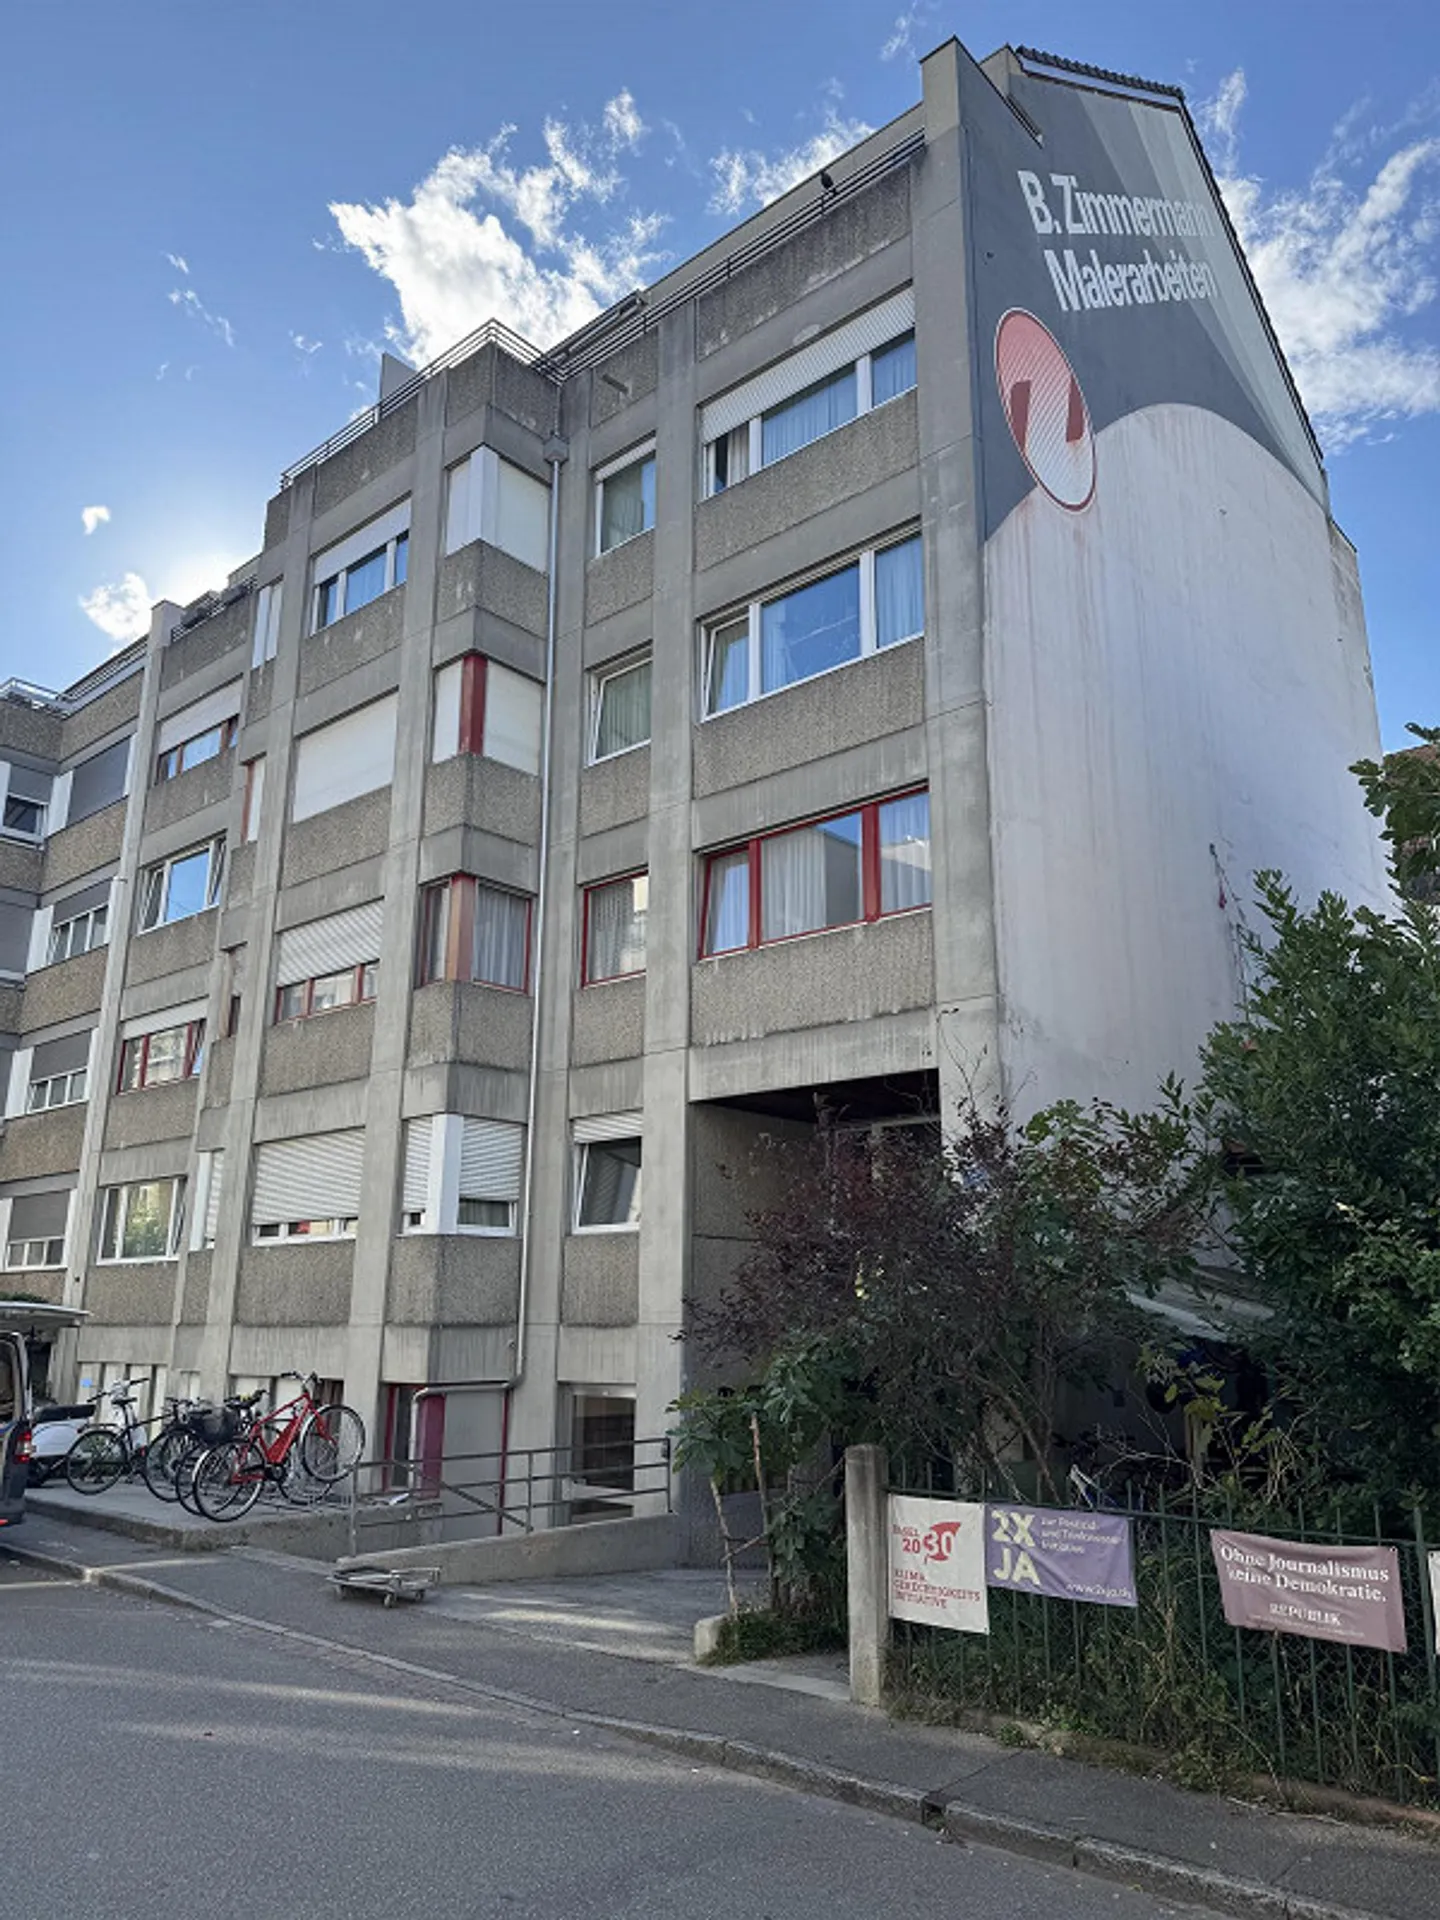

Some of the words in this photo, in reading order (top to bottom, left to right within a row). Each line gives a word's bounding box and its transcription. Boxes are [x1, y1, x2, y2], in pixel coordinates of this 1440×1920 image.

[1044, 249, 1218, 312] Malerarbeiten
[991, 1510, 1035, 1547] 2X
[993, 1548, 1041, 1587] JA
[1221, 1547, 1266, 1567] Ohne
[1267, 1553, 1389, 1582] Journalismus
[1275, 1574, 1387, 1602] Demokratie.
[1269, 1602, 1341, 1626] REPUBLIK
